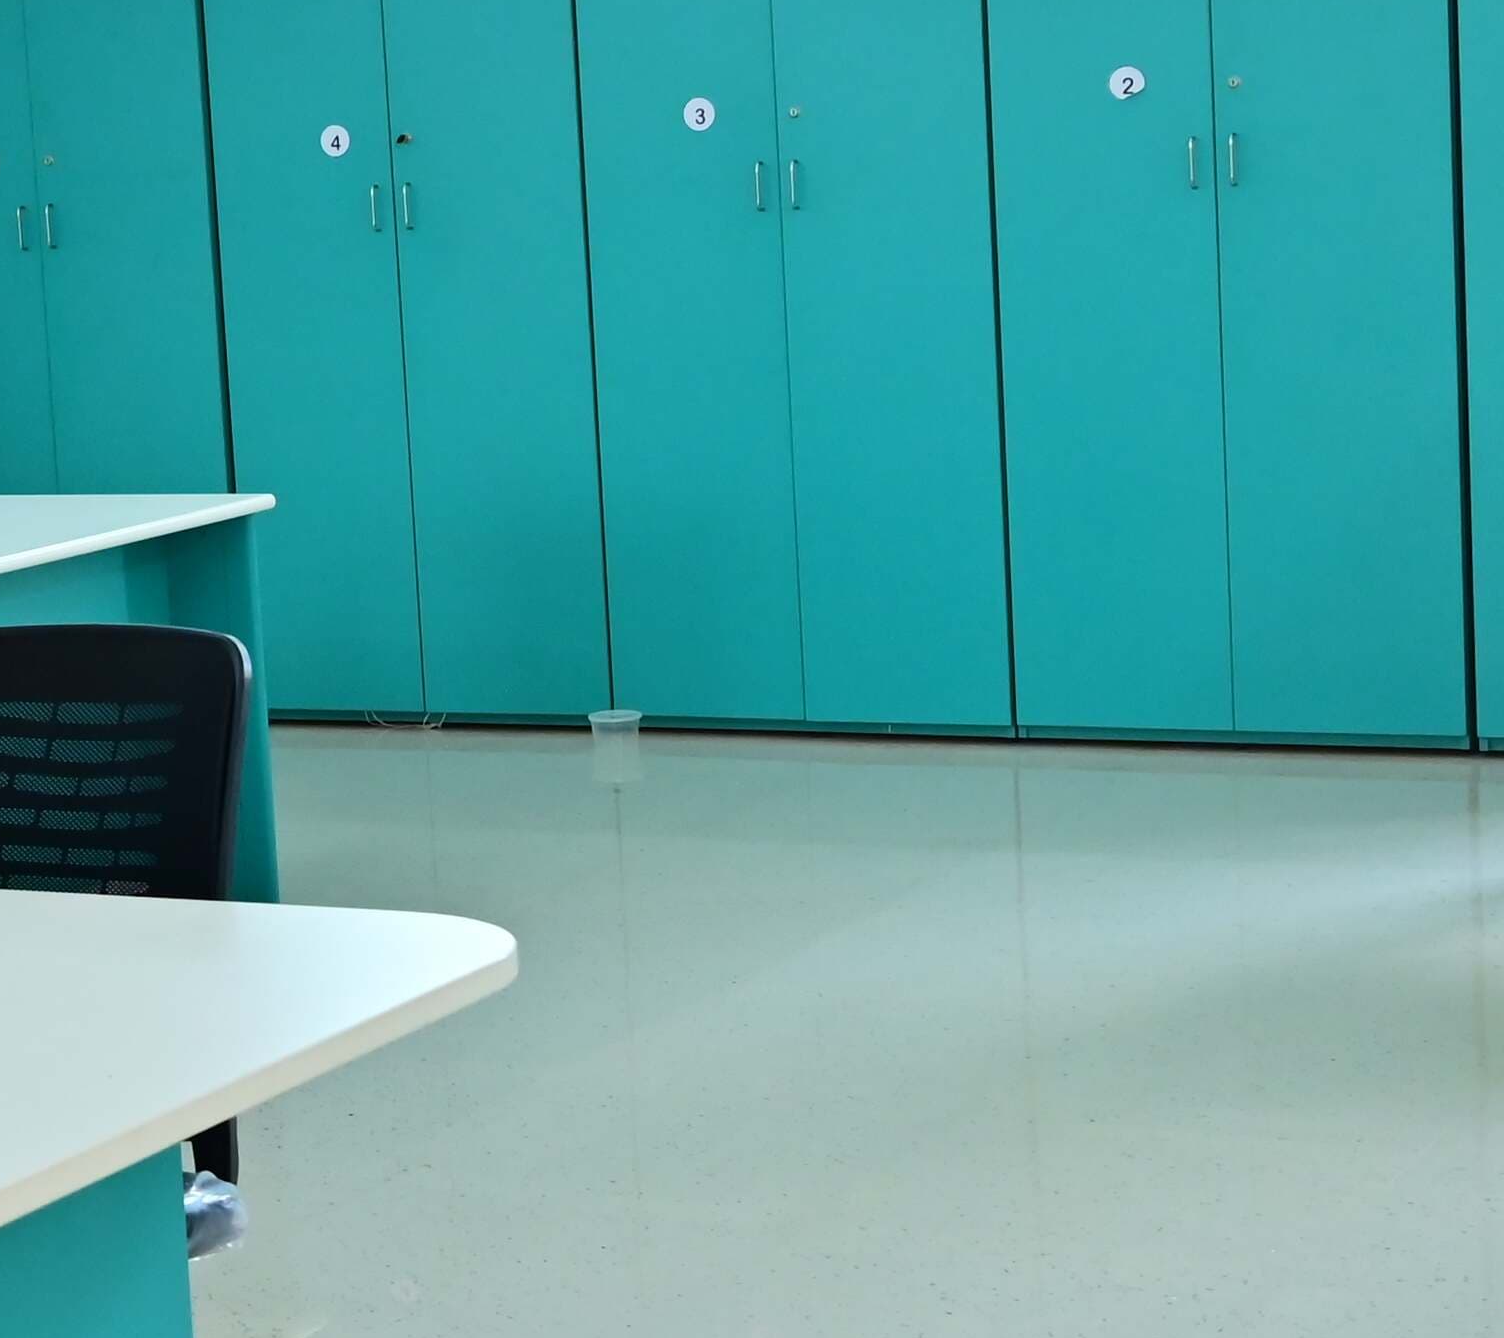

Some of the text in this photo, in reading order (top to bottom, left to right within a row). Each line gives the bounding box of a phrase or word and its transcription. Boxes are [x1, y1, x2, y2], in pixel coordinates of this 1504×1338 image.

[1122, 77, 1134, 95] 2
[695, 108, 706, 125] 3
[330, 135, 341, 151] 4
